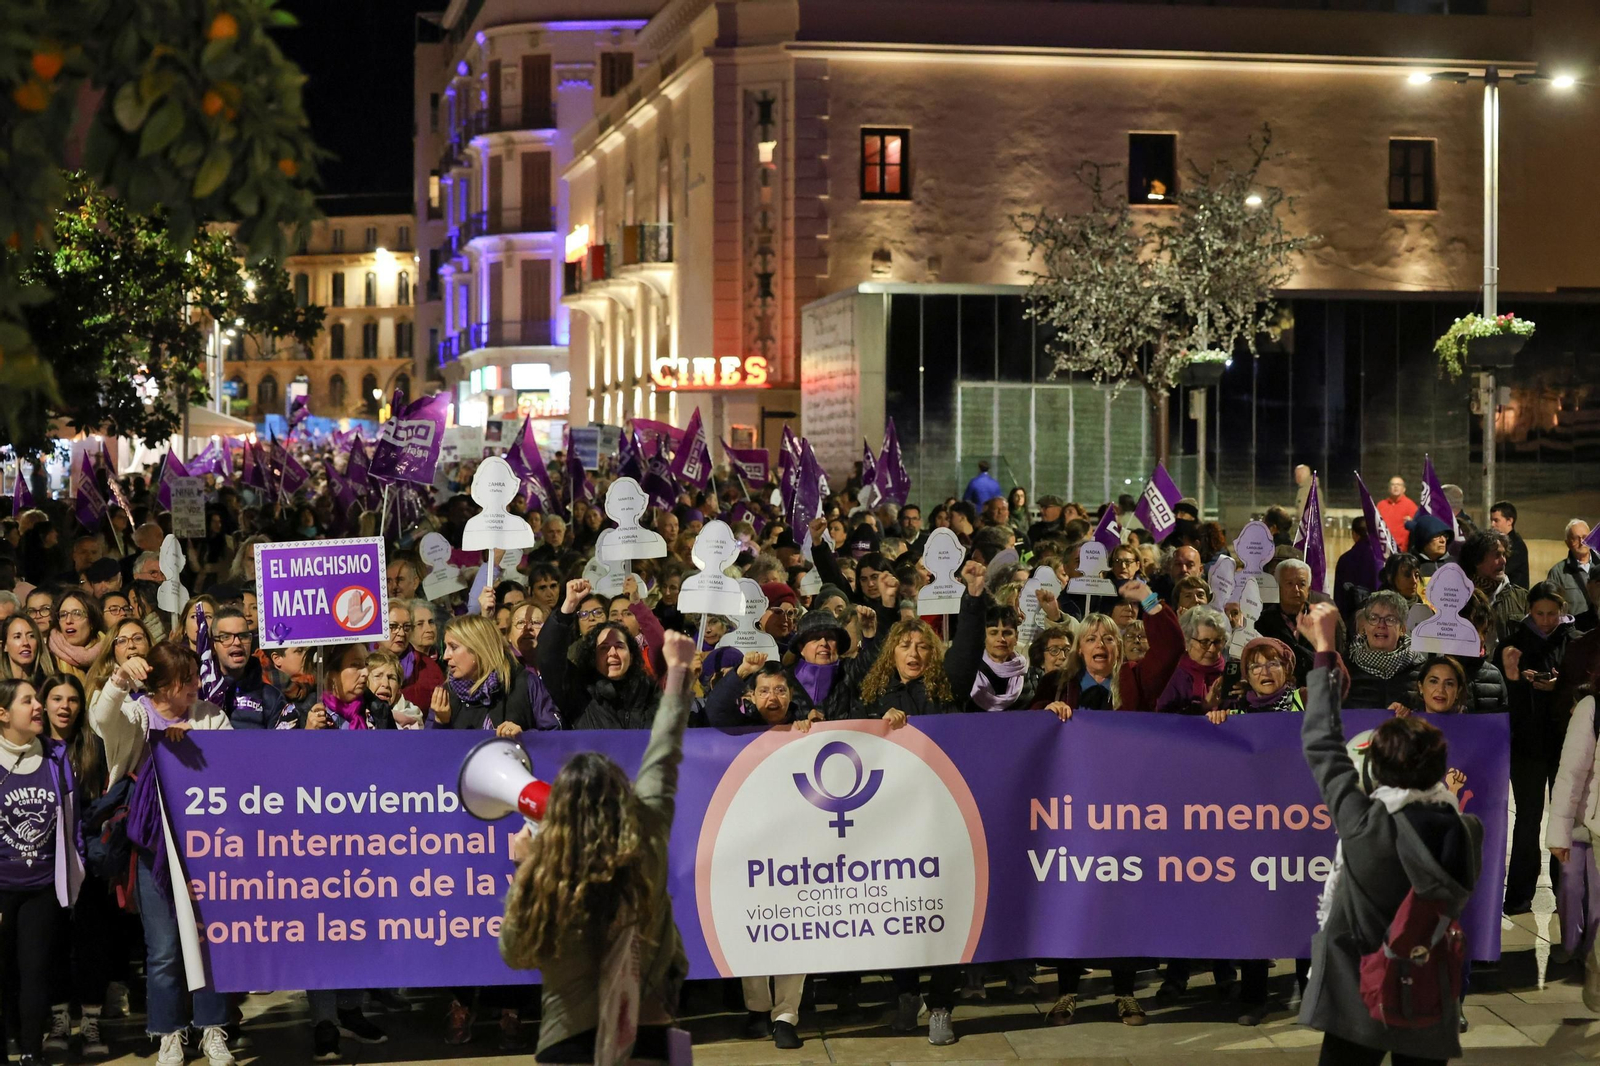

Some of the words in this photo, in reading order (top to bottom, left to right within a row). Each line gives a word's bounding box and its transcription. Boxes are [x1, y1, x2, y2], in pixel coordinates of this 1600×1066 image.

[651, 356, 767, 387] CINES
[1146, 487, 1172, 524] CCOO
[270, 559, 287, 579] EL
[290, 554, 372, 578] MACHISMO
[272, 588, 330, 618] MATA
[4, 787, 56, 806] JUNTAS
[18, 798, 42, 806] CONTRA
[185, 787, 227, 815] 25
[239, 785, 285, 814] de
[296, 784, 469, 814] Noviemb
[1029, 795, 1072, 831] Ni
[1087, 802, 1169, 831] una
[186, 827, 244, 858] Día
[257, 825, 495, 857] Internacional
[747, 854, 940, 887] Plataforma
[1027, 847, 1143, 882] Vivas
[1158, 855, 1236, 882] nos
[1250, 853, 1331, 890] que
[188, 868, 398, 901] eliminación
[410, 868, 455, 897] de
[466, 868, 495, 896] la
[797, 884, 858, 901] contra
[863, 883, 888, 898] las
[746, 901, 842, 921] violencias
[848, 895, 944, 916] machistas
[318, 912, 366, 942] las
[378, 910, 502, 946] mujere
[745, 918, 875, 943] VIOLENCIA
[883, 914, 945, 935] CERO
